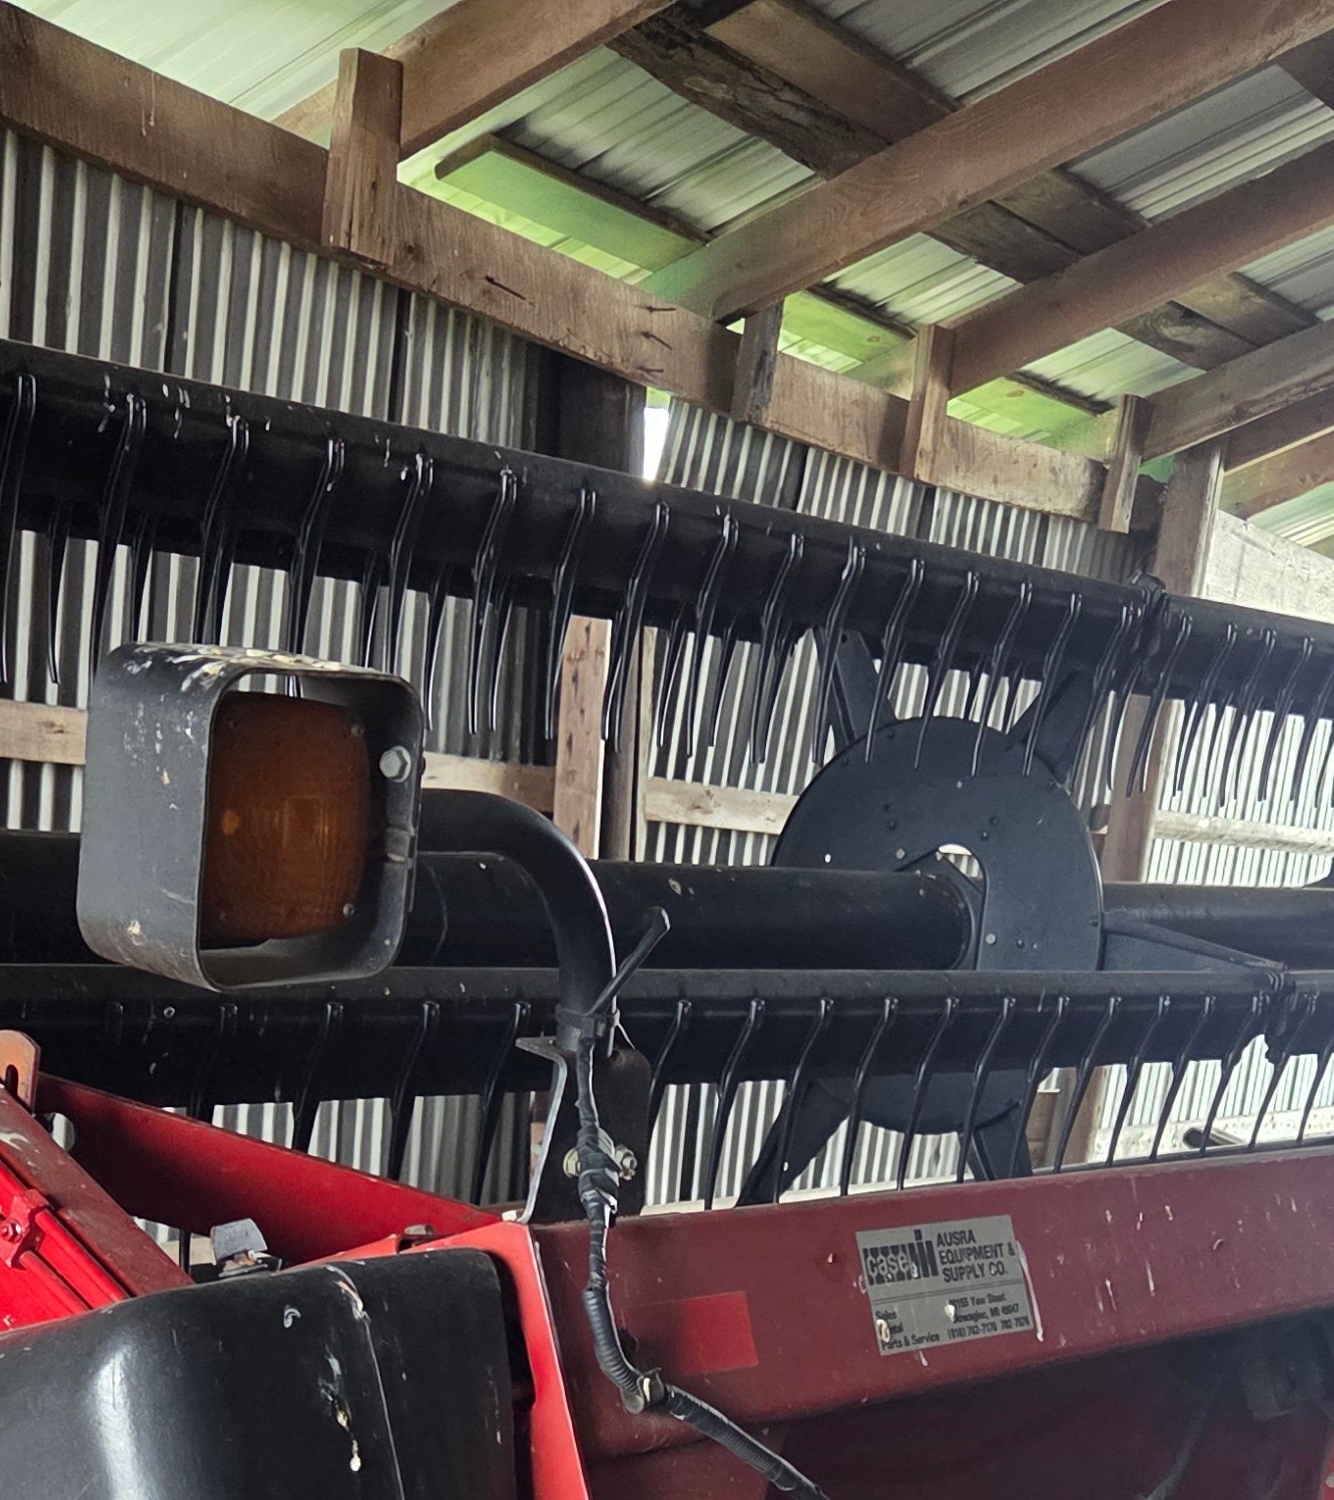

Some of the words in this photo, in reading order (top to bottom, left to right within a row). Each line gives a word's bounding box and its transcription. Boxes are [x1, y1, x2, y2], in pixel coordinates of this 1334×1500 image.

[937, 1229, 976, 1247] AUSRA
[1007, 1243, 1016, 1256] &
[942, 1263, 986, 1283] SUPPLY
[911, 1331, 940, 1345] Service
